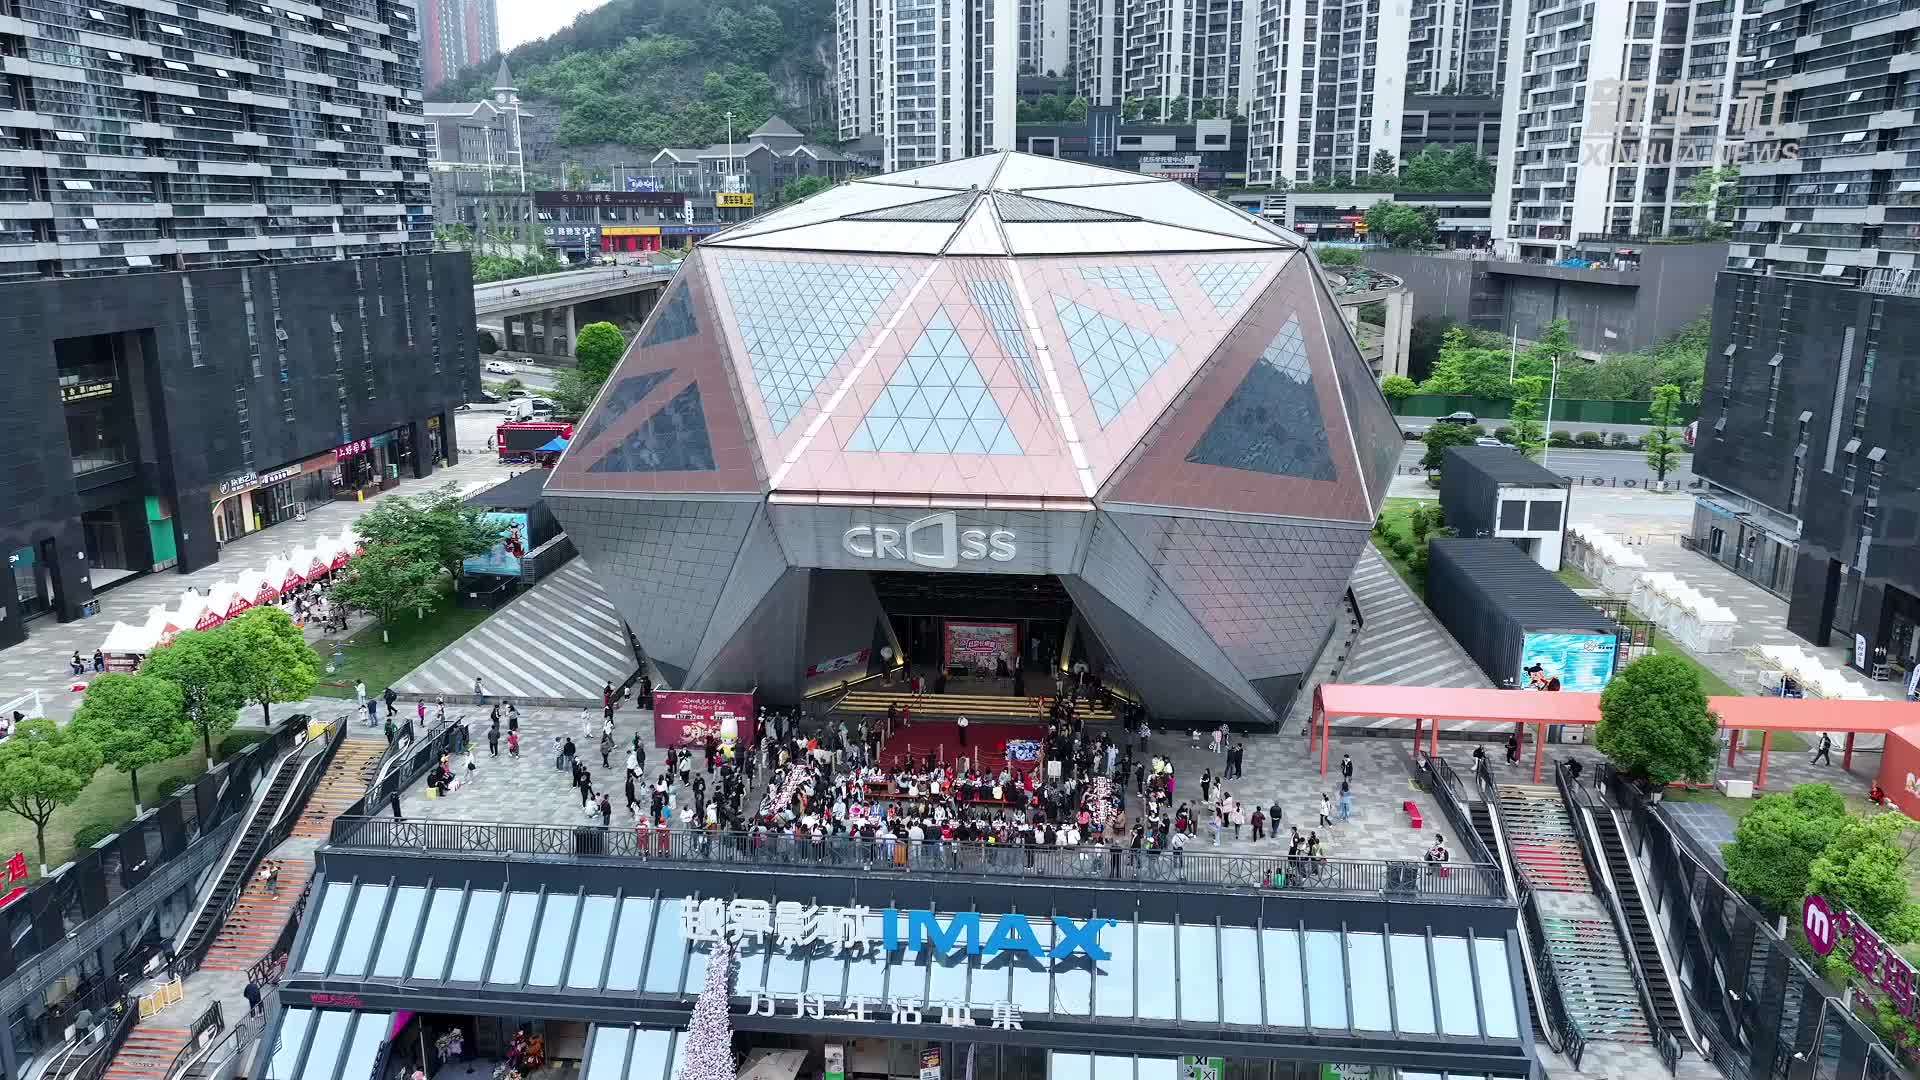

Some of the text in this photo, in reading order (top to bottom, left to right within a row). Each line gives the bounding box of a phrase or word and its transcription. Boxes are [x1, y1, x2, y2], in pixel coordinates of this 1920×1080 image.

[842, 510, 1017, 569] CROSS
[681, 895, 870, 955] 越界影城
[883, 908, 1113, 961] IMAX
[747, 989, 1024, 1031] 方舟生活市集
